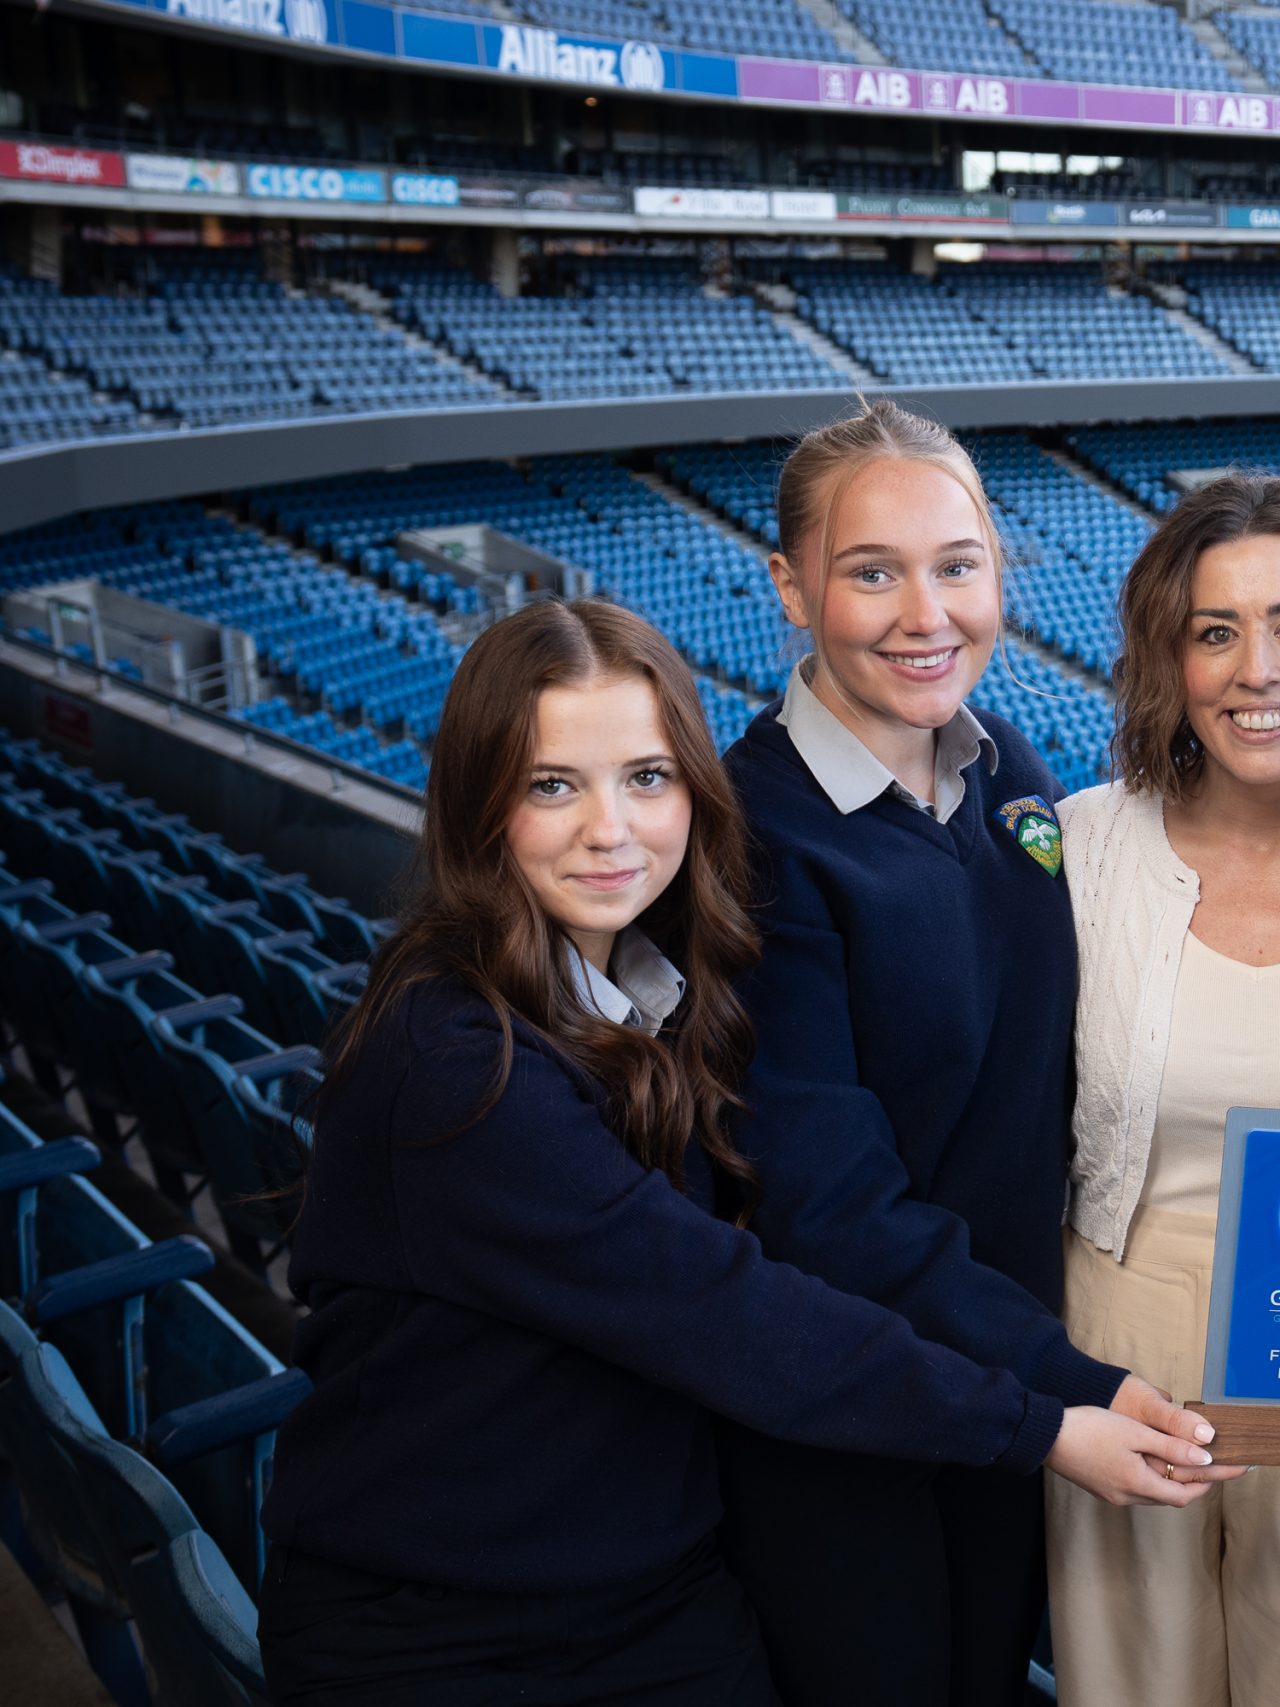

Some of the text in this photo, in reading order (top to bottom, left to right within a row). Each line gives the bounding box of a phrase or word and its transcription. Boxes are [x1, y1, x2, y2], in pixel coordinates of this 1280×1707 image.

[499, 25, 619, 85] Allianz
[854, 71, 911, 107] AIB
[955, 79, 1009, 113] AIB
[1218, 97, 1269, 128] AIB
[251, 165, 344, 199] CISCO
[393, 176, 459, 204] CISCO
